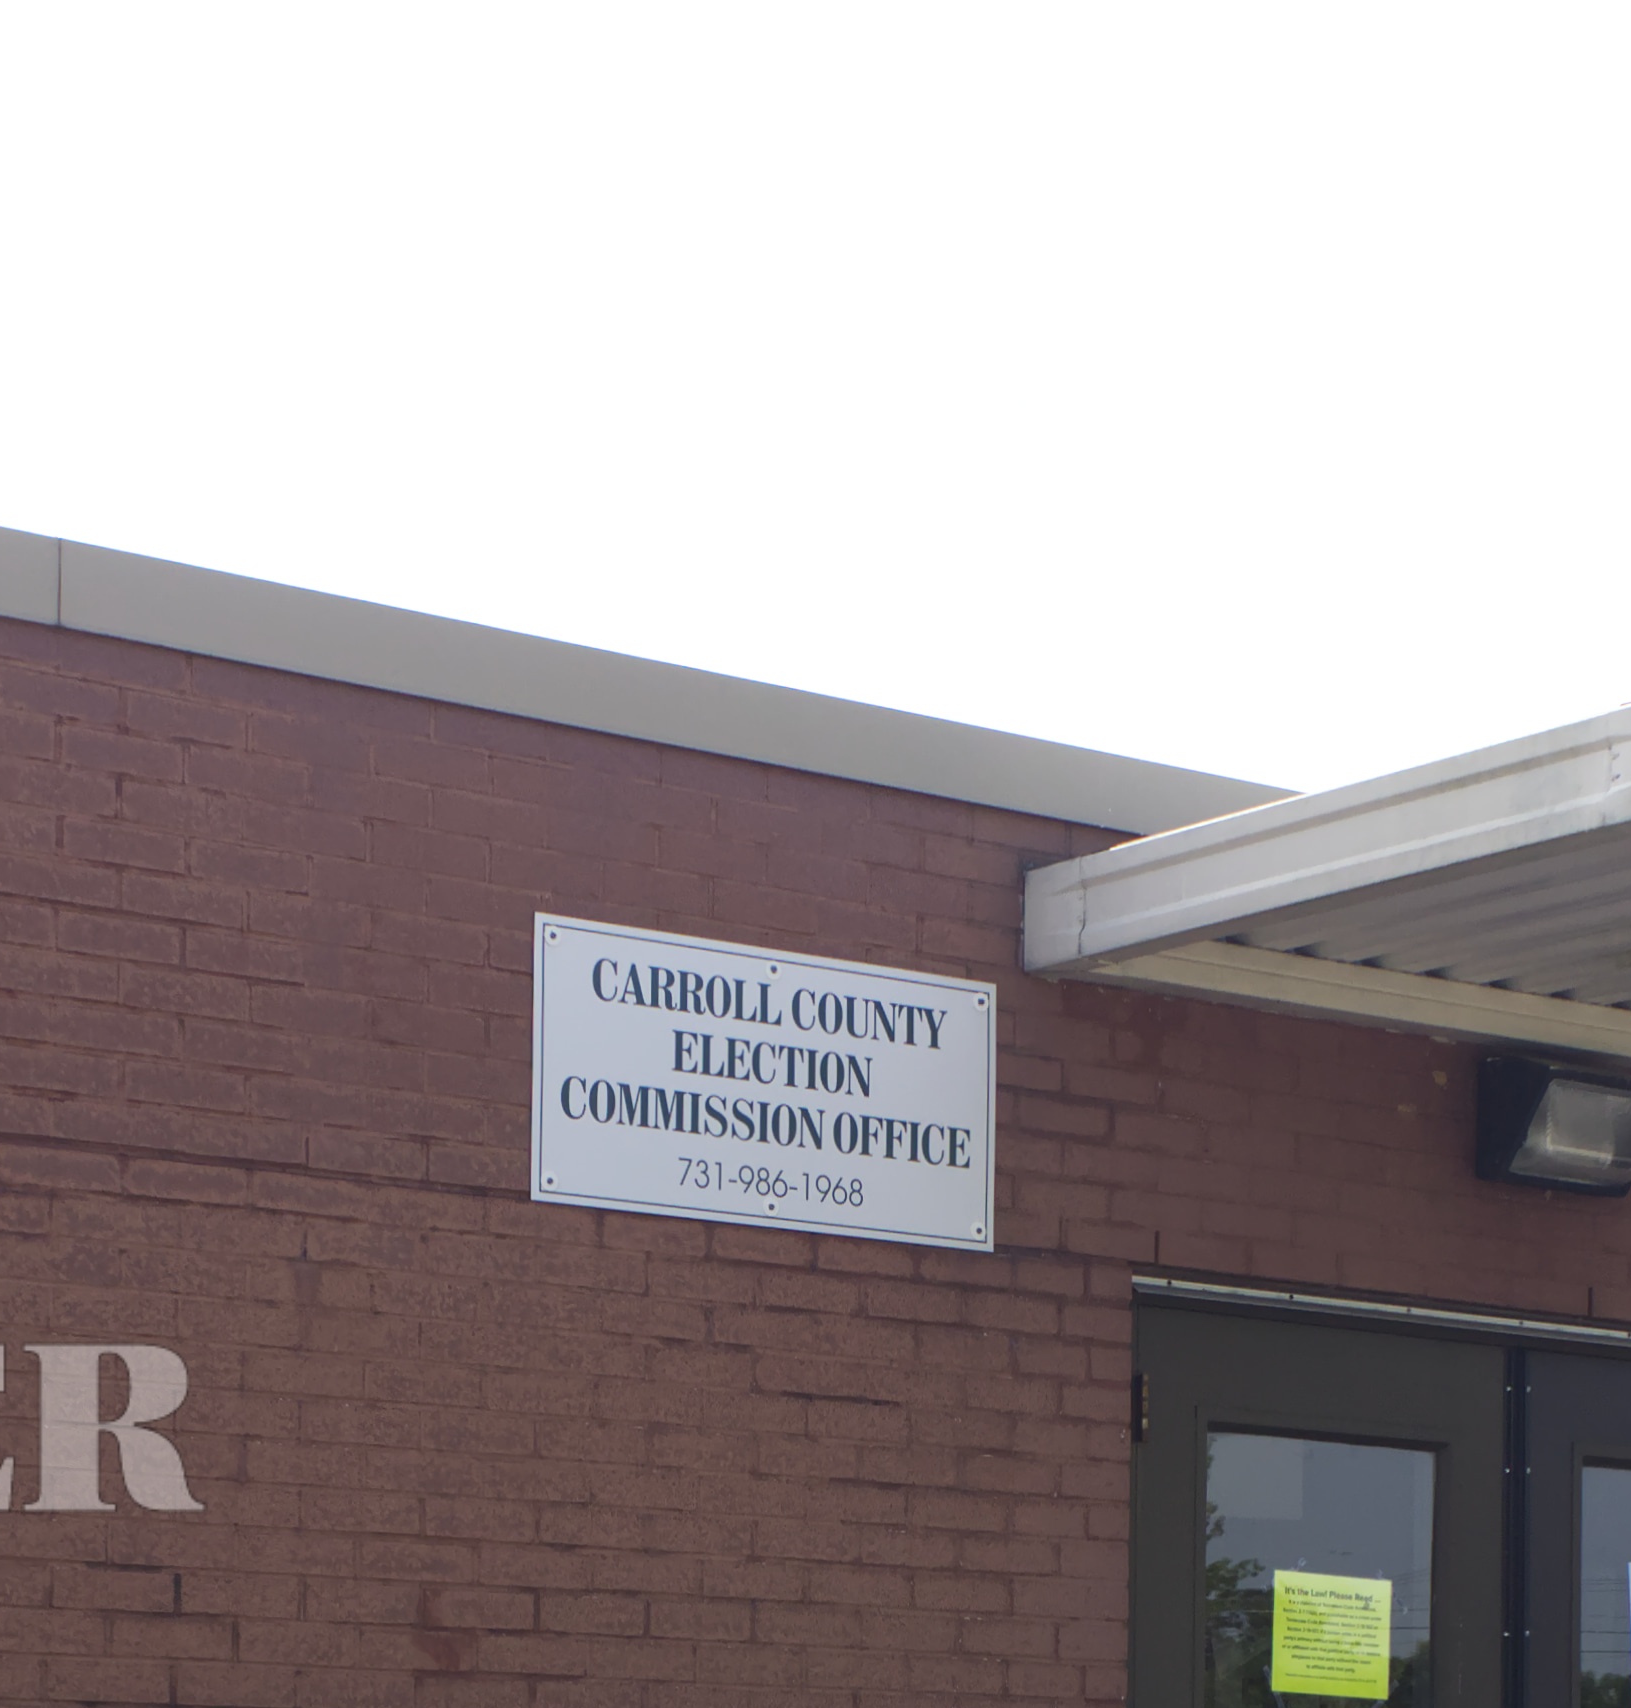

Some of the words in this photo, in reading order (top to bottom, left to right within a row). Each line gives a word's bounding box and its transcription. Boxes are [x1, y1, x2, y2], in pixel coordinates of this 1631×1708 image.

[591, 957, 783, 1027] CARROLL
[791, 987, 948, 1050] COUNTY
[671, 1029, 873, 1098] ELECTION
[560, 1075, 826, 1151] COMMISSION
[832, 1111, 972, 1169] OFFICE
[676, 1156, 865, 1208] 731-986-1968
